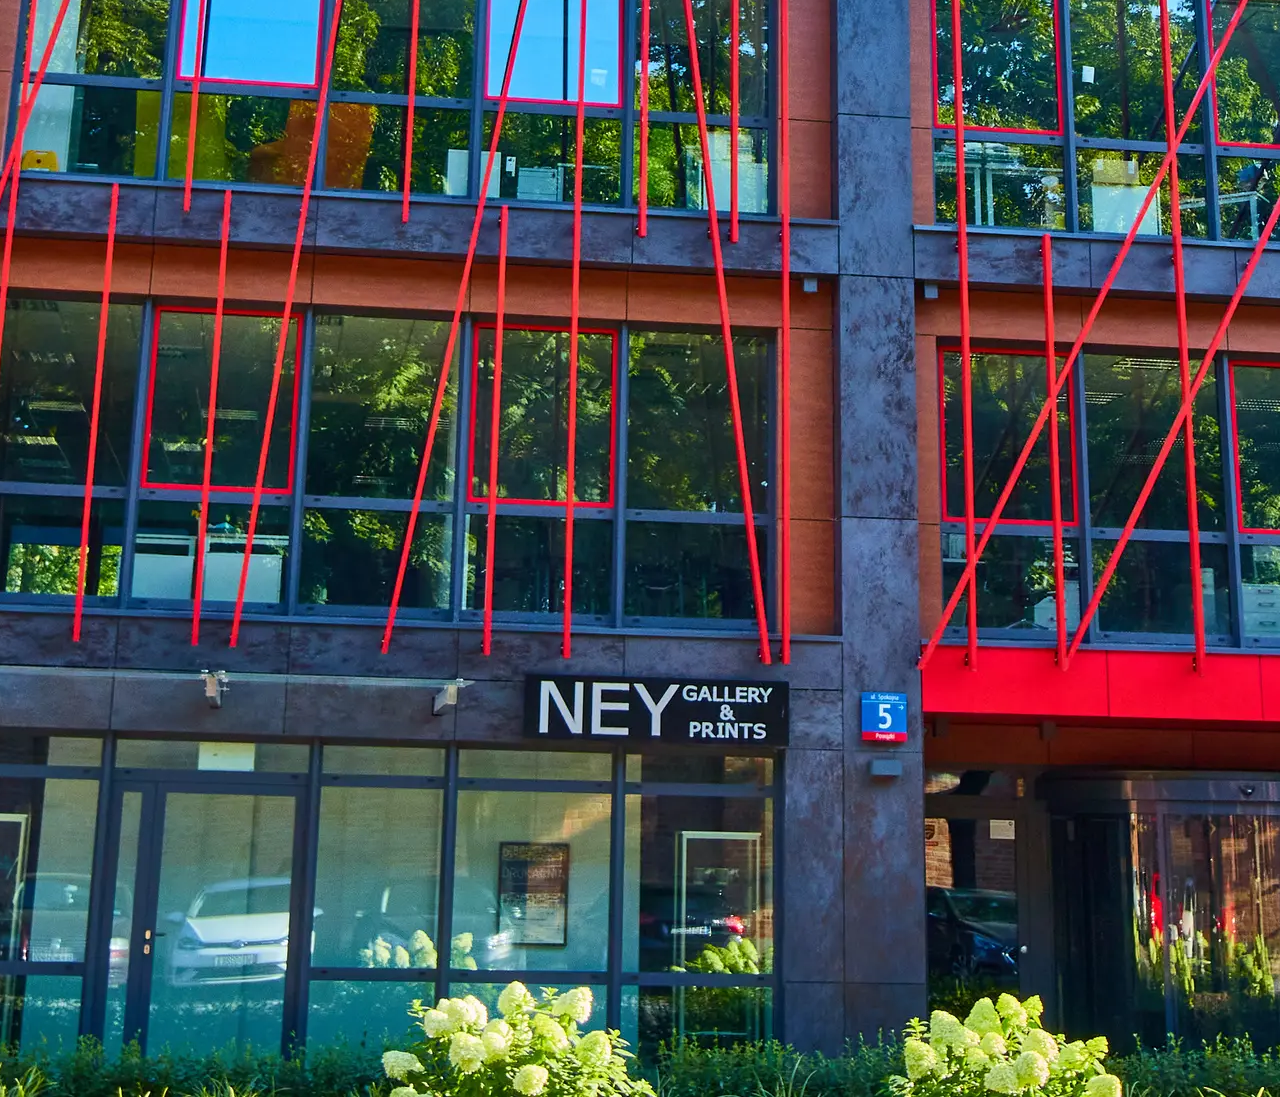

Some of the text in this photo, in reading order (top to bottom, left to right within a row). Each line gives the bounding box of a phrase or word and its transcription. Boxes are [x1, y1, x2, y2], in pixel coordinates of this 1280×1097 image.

[682, 685, 773, 703] GALLERY
[538, 680, 680, 737] NEY
[719, 704, 736, 721] &
[878, 703, 892, 729] 5
[689, 722, 767, 739] PRINTS
